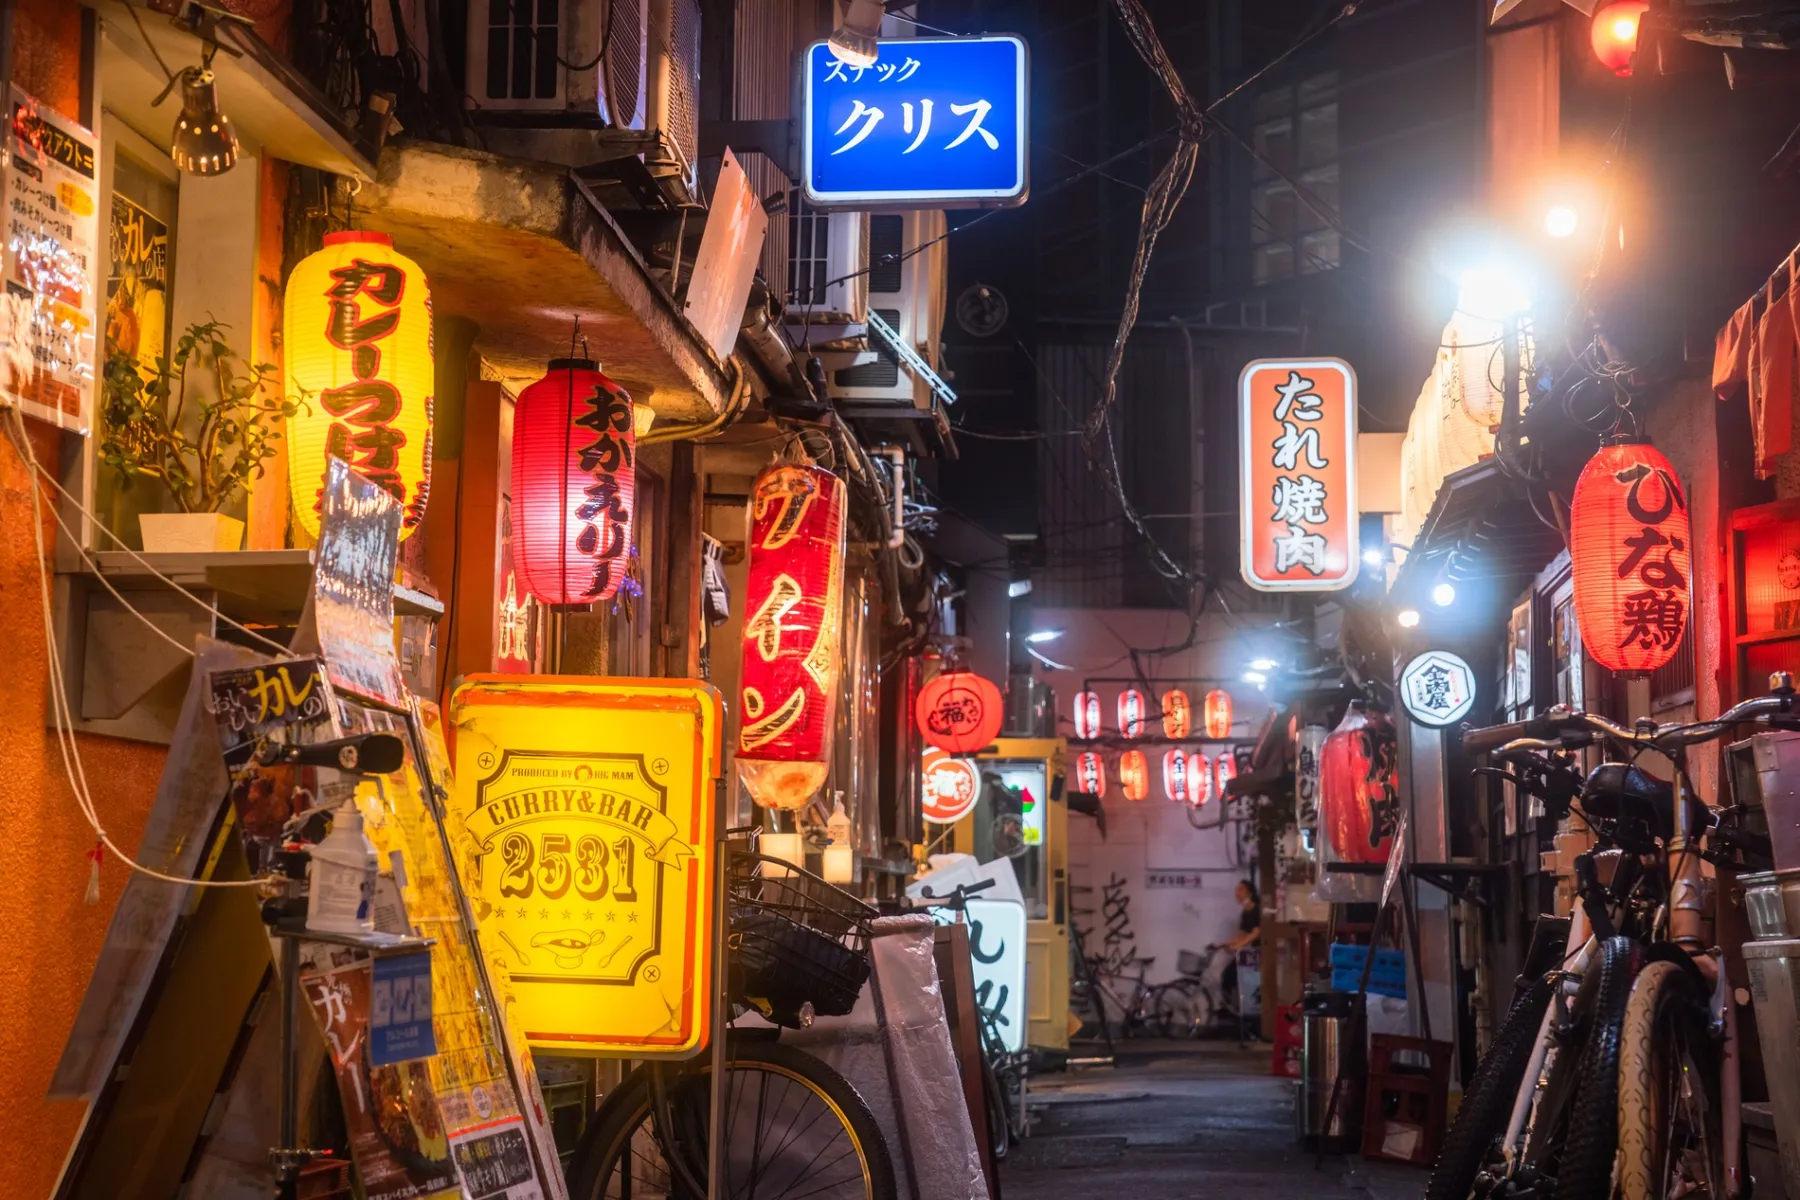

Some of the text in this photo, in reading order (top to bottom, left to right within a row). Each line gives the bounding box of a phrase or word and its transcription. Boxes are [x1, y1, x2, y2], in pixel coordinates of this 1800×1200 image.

[823, 57, 921, 83] スナック
[831, 98, 999, 156] クリス
[315, 258, 407, 525] カレーつけ
[1272, 371, 1329, 575] たれ焼肉
[1615, 464, 1686, 650] ひな鶏
[486, 789, 654, 832] CURRY&BAR
[611, 771, 635, 781] MAM
[500, 832, 638, 903] 2531
[314, 984, 366, 1114] カレー
